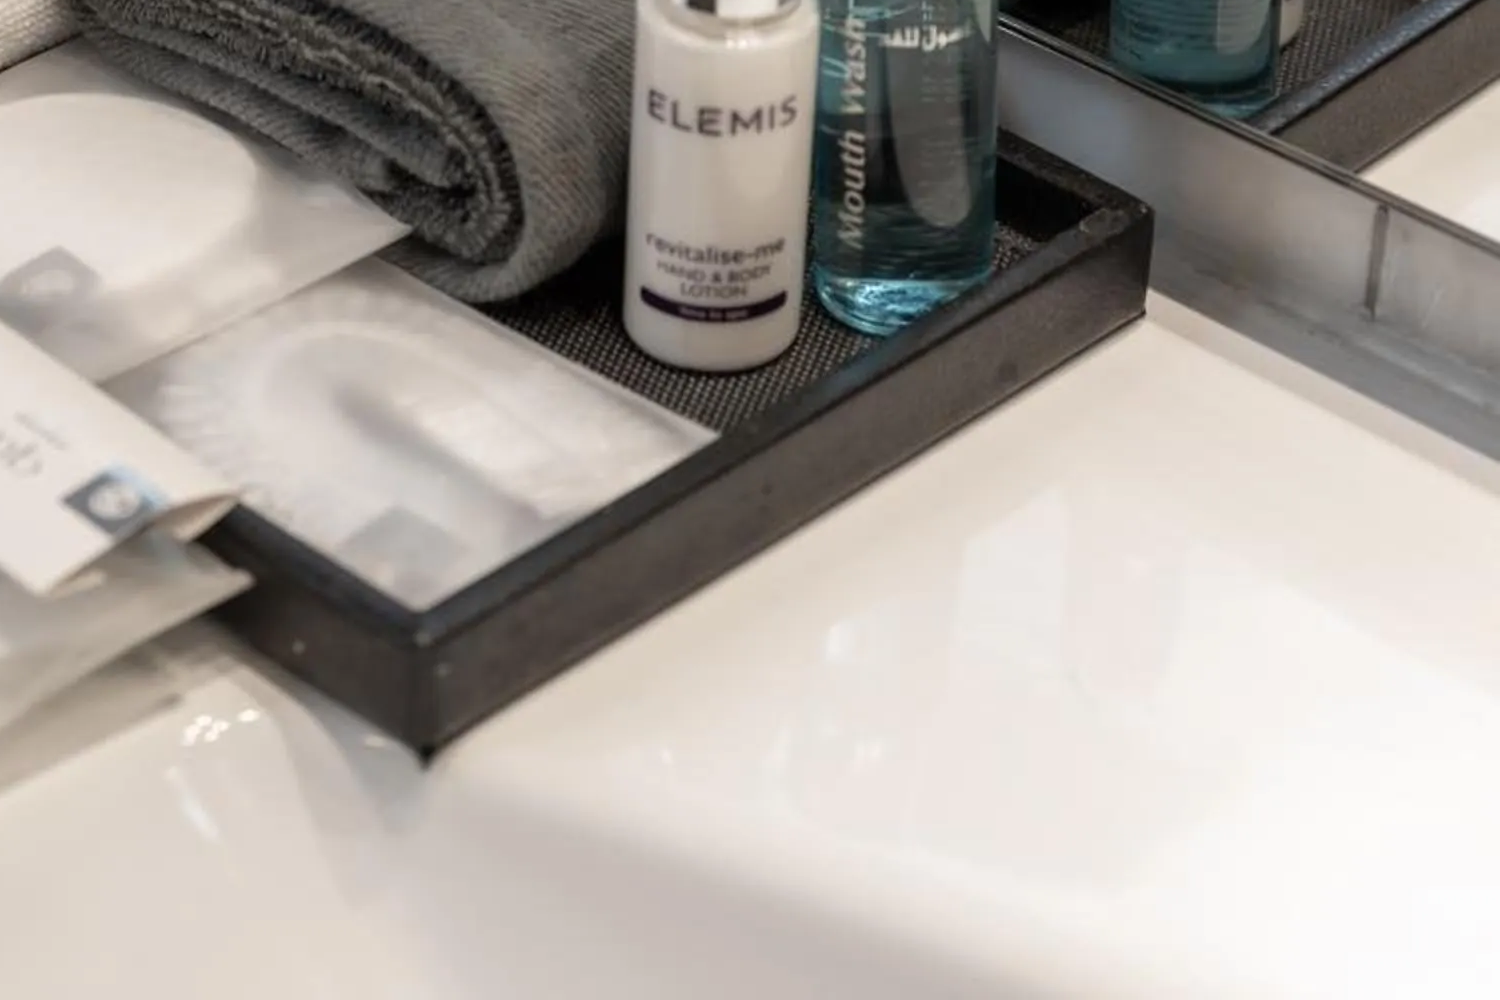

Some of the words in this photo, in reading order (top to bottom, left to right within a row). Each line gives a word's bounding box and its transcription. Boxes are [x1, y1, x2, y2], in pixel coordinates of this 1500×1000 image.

[646, 88, 798, 137] ELEMIS
[837, 128, 867, 250] Mouth
[646, 232, 786, 265] revitalise-me
[679, 282, 748, 299] LOTION
